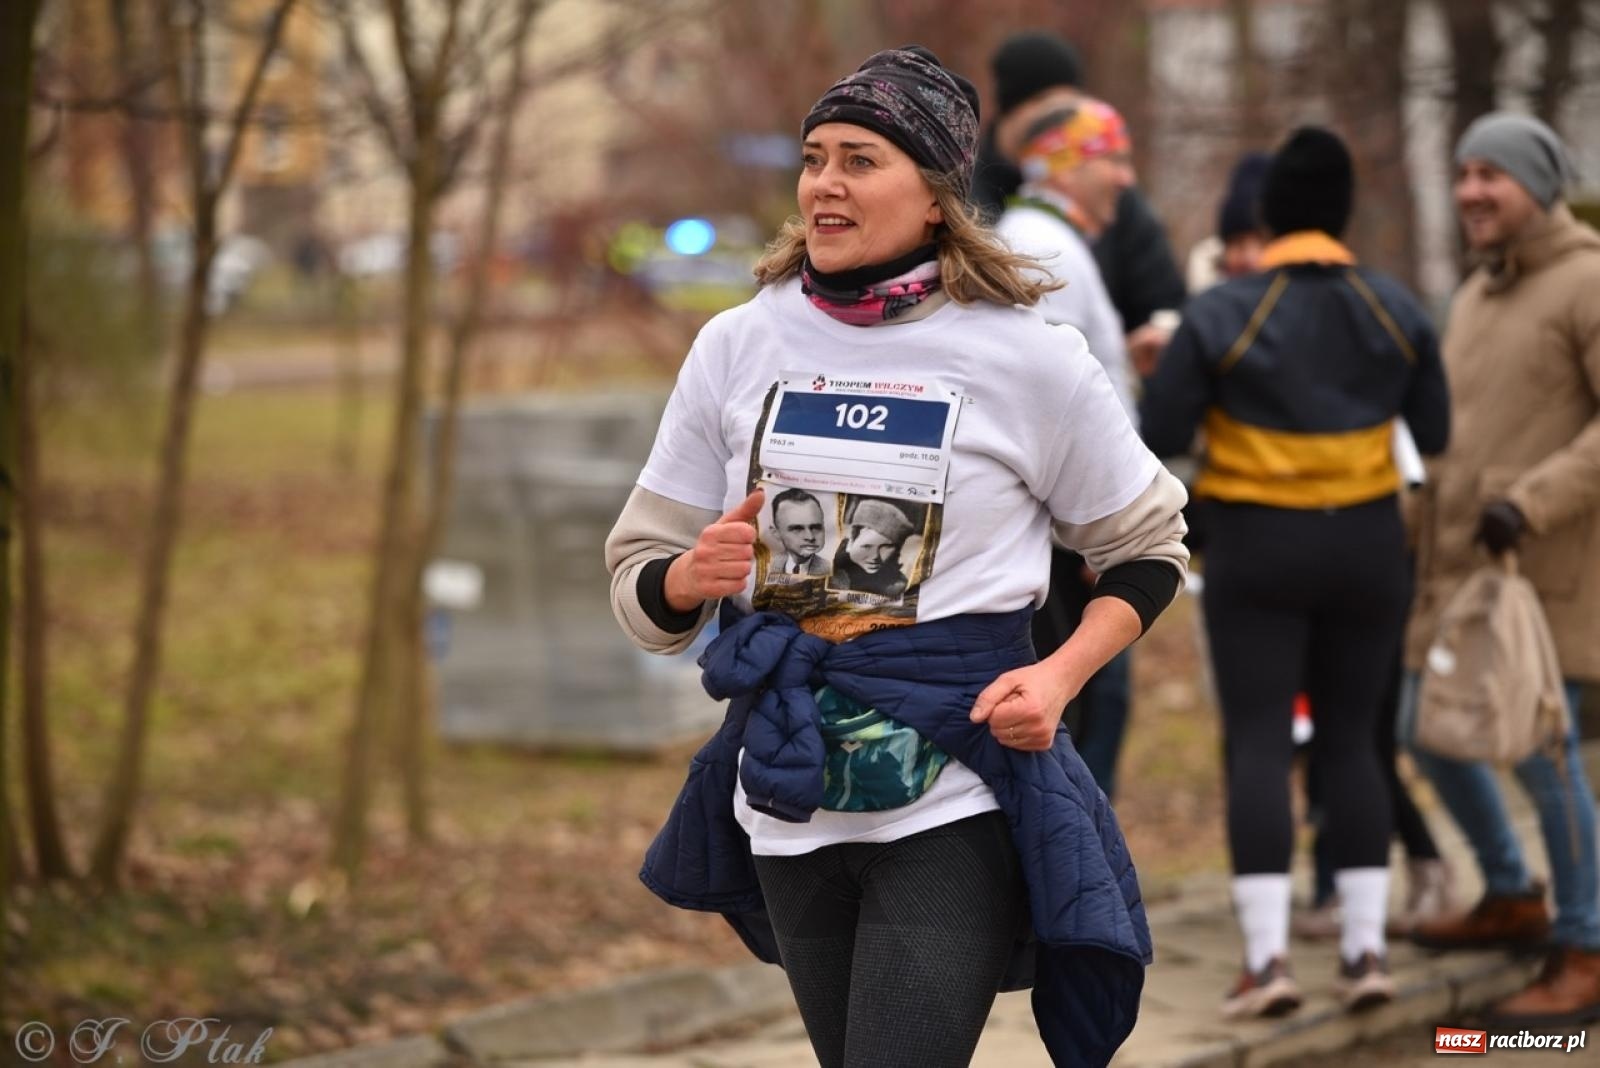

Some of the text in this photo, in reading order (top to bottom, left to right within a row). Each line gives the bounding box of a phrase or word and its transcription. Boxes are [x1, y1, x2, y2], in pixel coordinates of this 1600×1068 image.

[828, 380, 924, 393] TROPEM WILCZYM
[835, 403, 889, 431] 102
[769, 438, 787, 447] 1963
[899, 451, 940, 462] godz. 11.00
